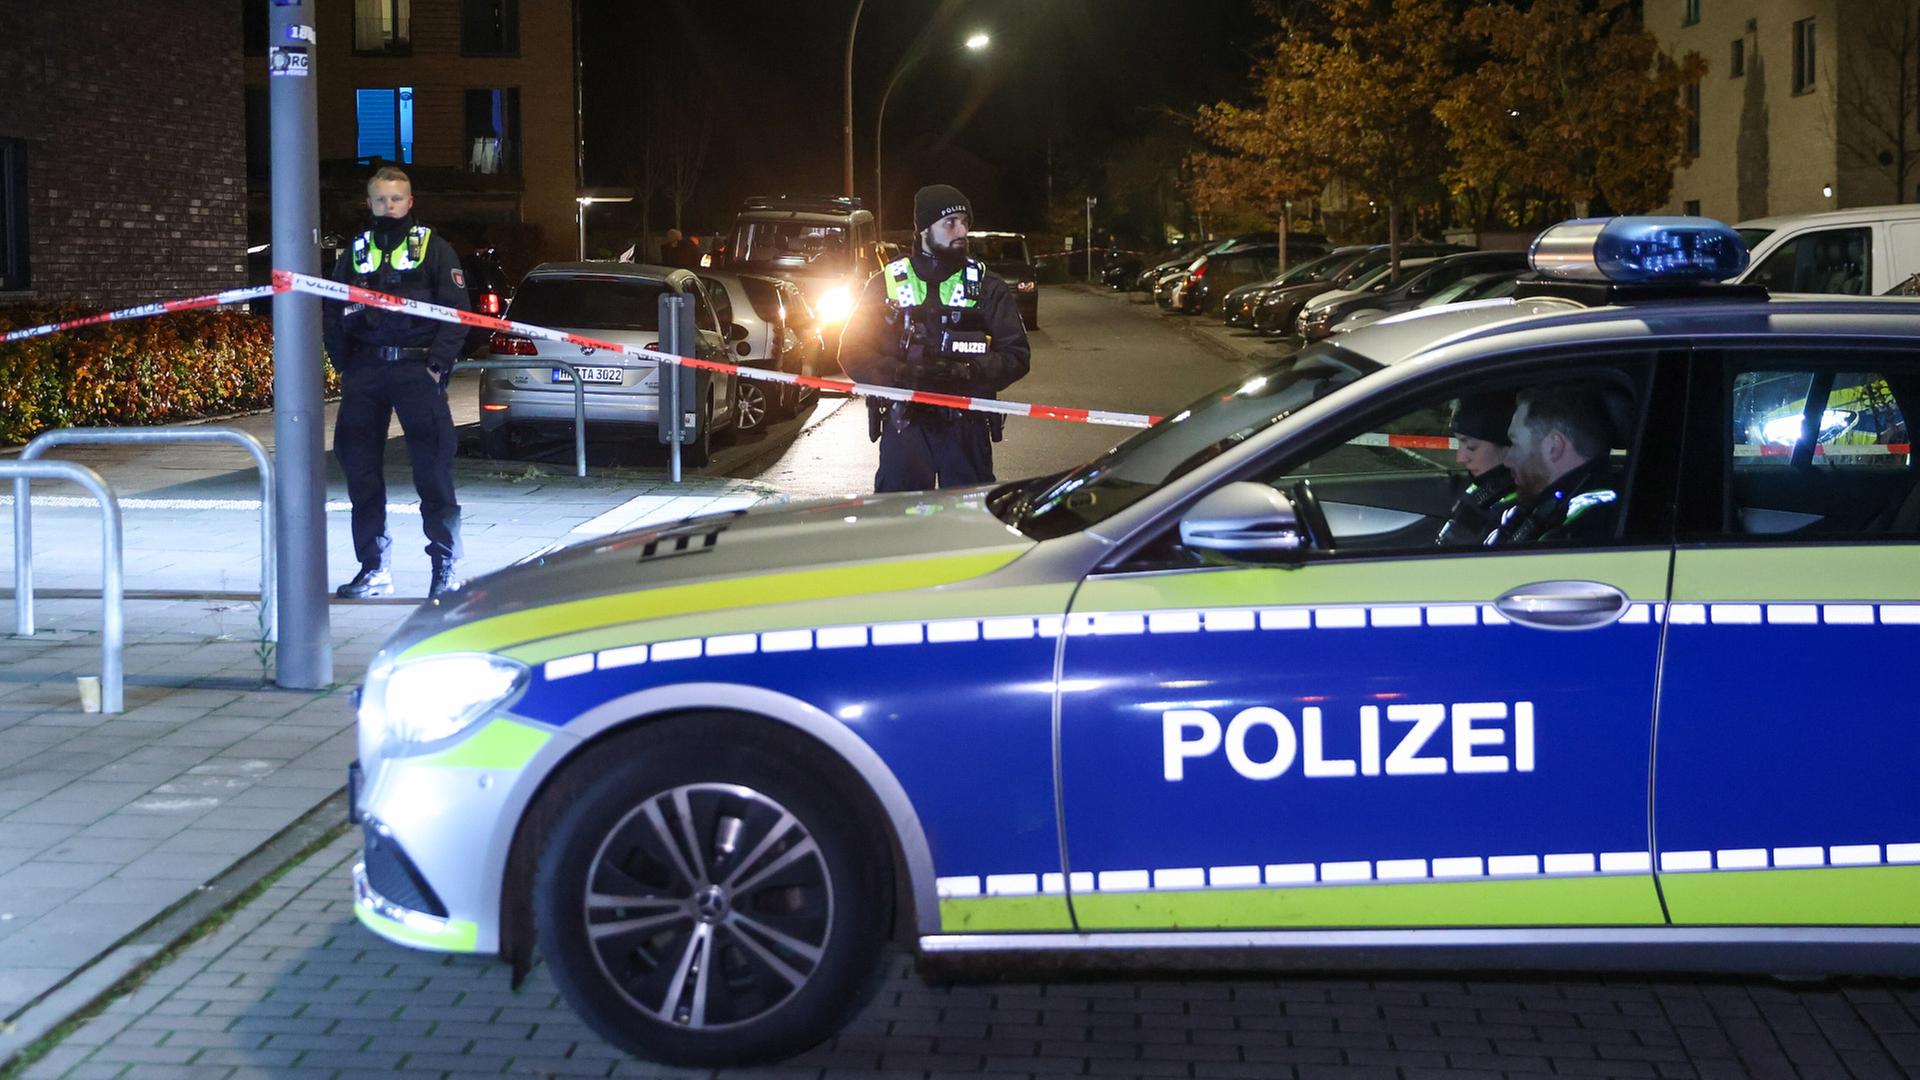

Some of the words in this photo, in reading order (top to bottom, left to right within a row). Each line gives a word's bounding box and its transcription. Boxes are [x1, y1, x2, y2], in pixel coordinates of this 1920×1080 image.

[952, 341, 987, 354] POLIZEI
[582, 369, 594, 379] TA
[596, 369, 621, 380] 3022
[1162, 701, 1535, 781] POLIZEI
